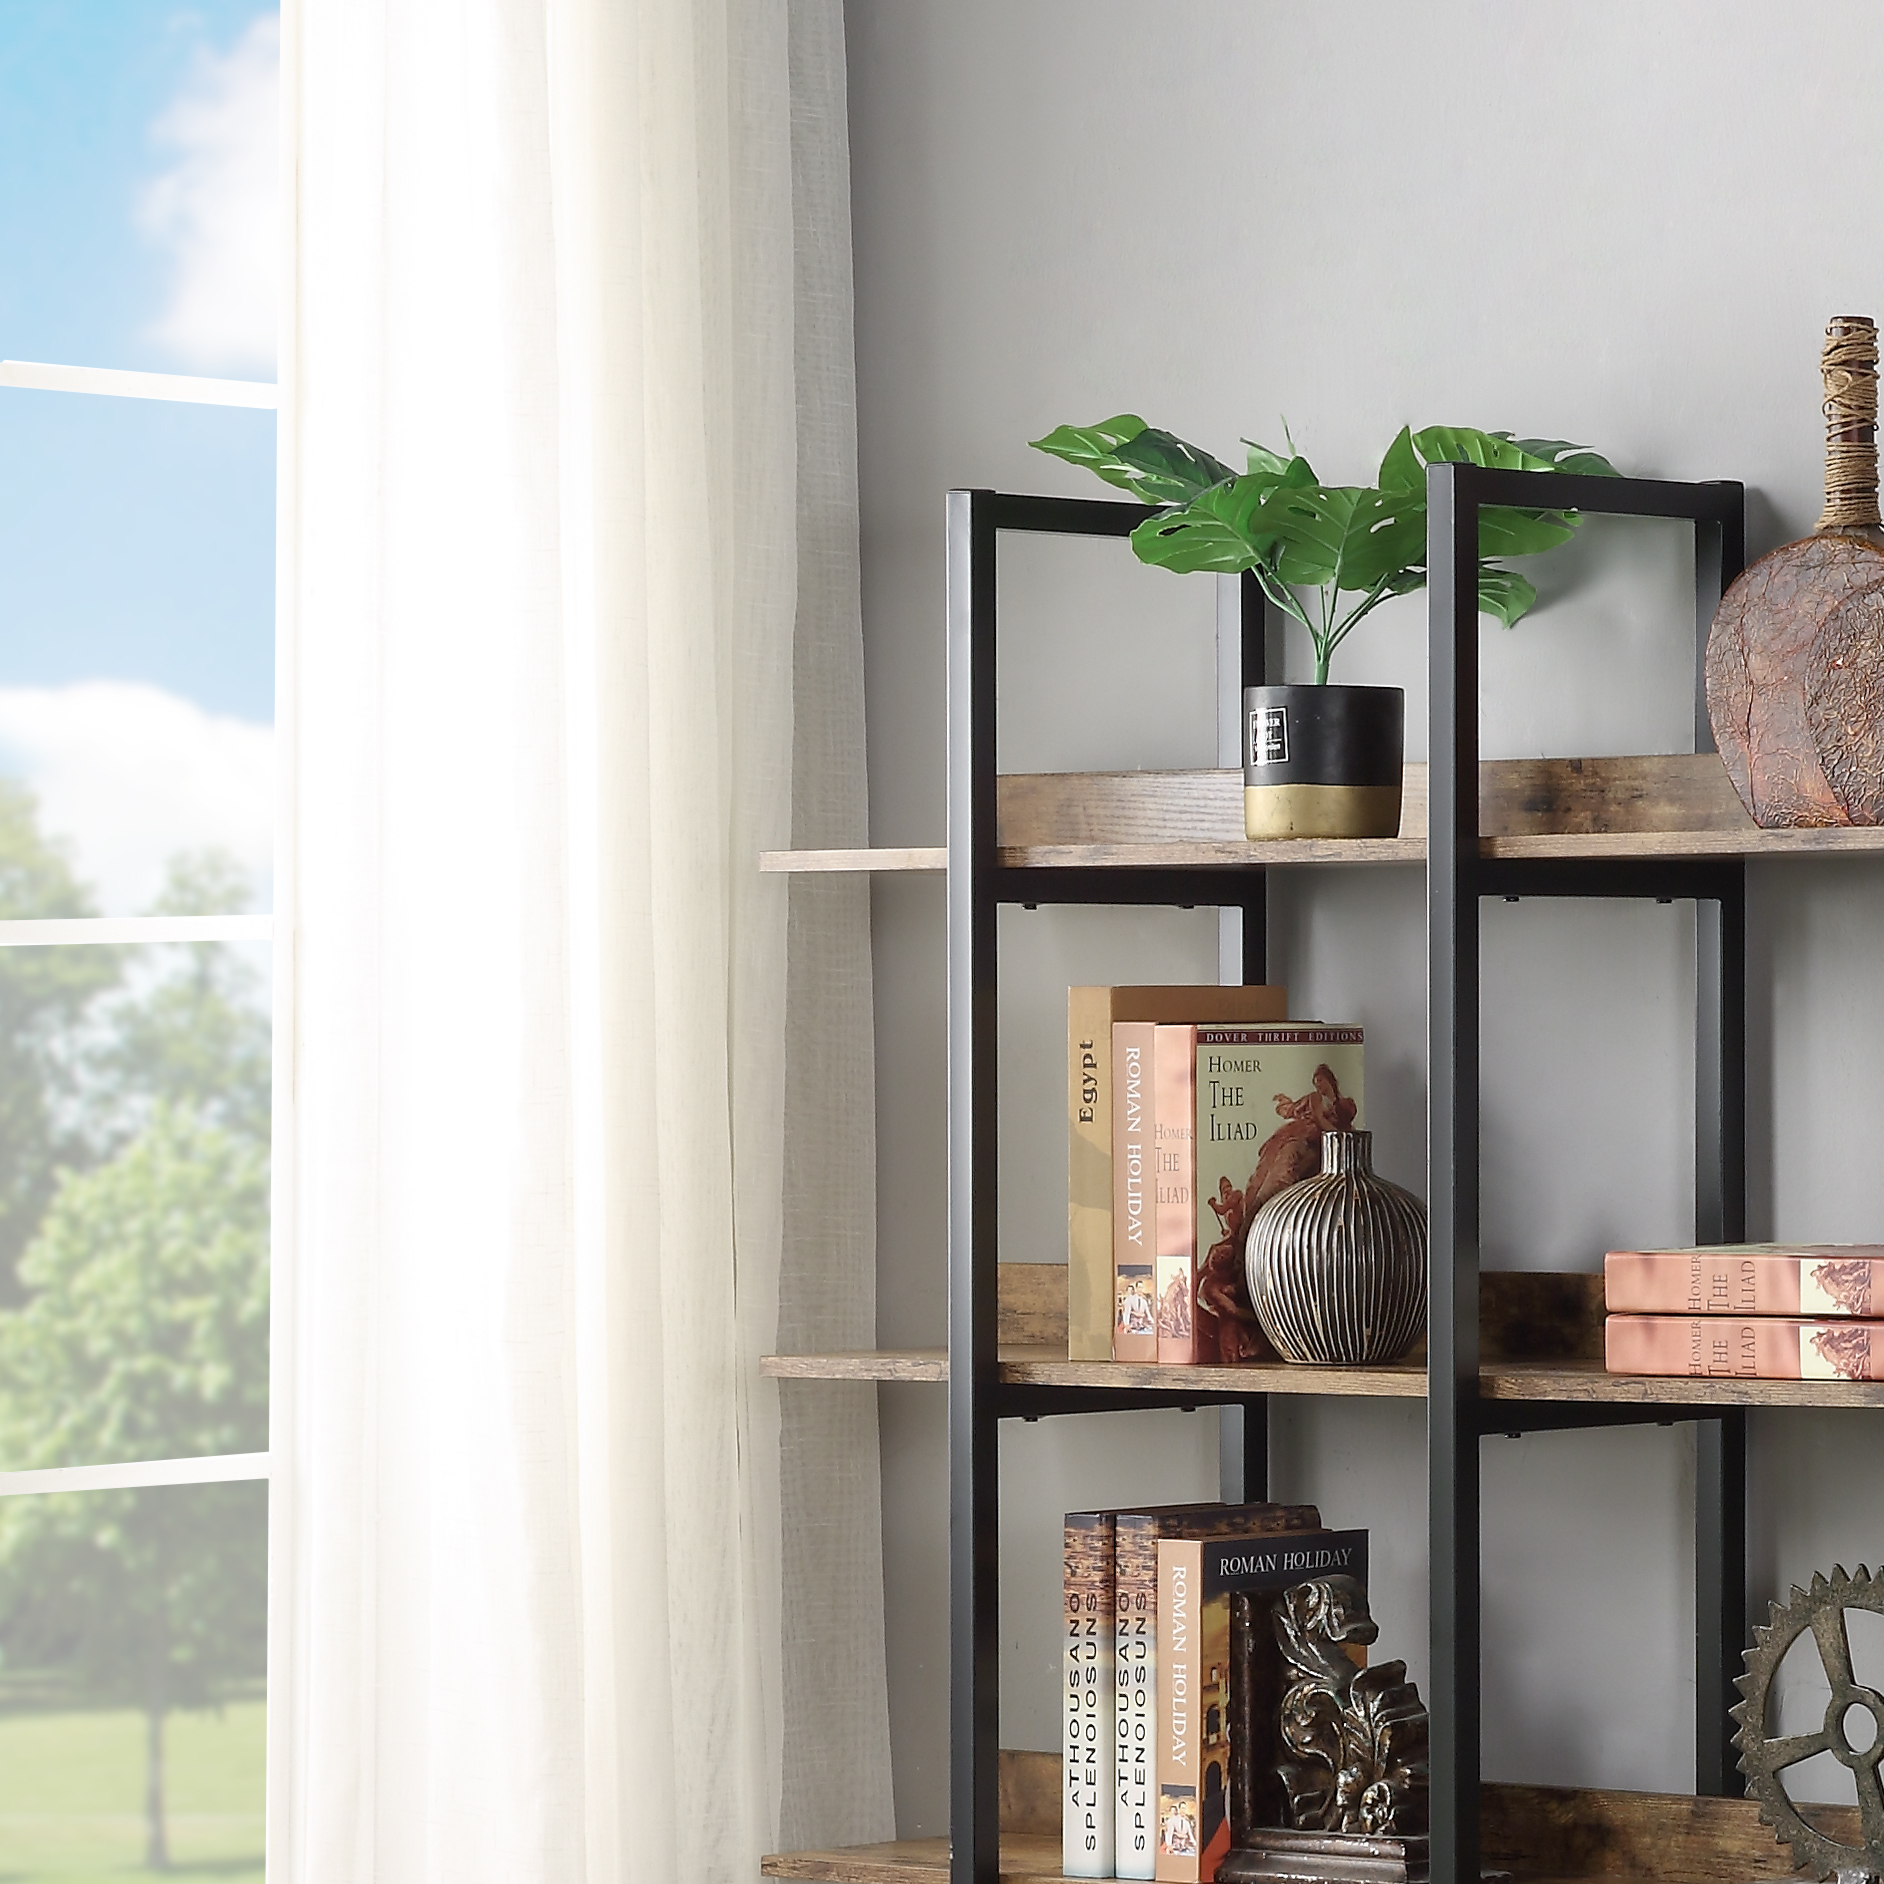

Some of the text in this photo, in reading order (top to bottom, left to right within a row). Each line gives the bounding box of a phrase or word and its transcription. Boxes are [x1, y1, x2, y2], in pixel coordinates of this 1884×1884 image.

[1206, 1031, 1363, 1042] DOVER THRIFT EDITIONS
[1079, 1039, 1098, 1123] Egypt
[1208, 1056, 1261, 1073] HOMER
[1209, 1080, 1244, 1109] THE
[1209, 1114, 1257, 1141] ILIAD
[1126, 1047, 1143, 1246] ROMAN HOLIDAY
[1155, 1147, 1180, 1173] THE
[1707, 1274, 1729, 1311] THE
[1733, 1260, 1755, 1311] ILIAD
[1707, 1340, 1731, 1376] THE
[1735, 1326, 1757, 1376] ILIAD
[1219, 1548, 1353, 1576] ROMAN HOLIDAY
[1172, 1566, 1187, 1766] ROMAN HOLIDAY
